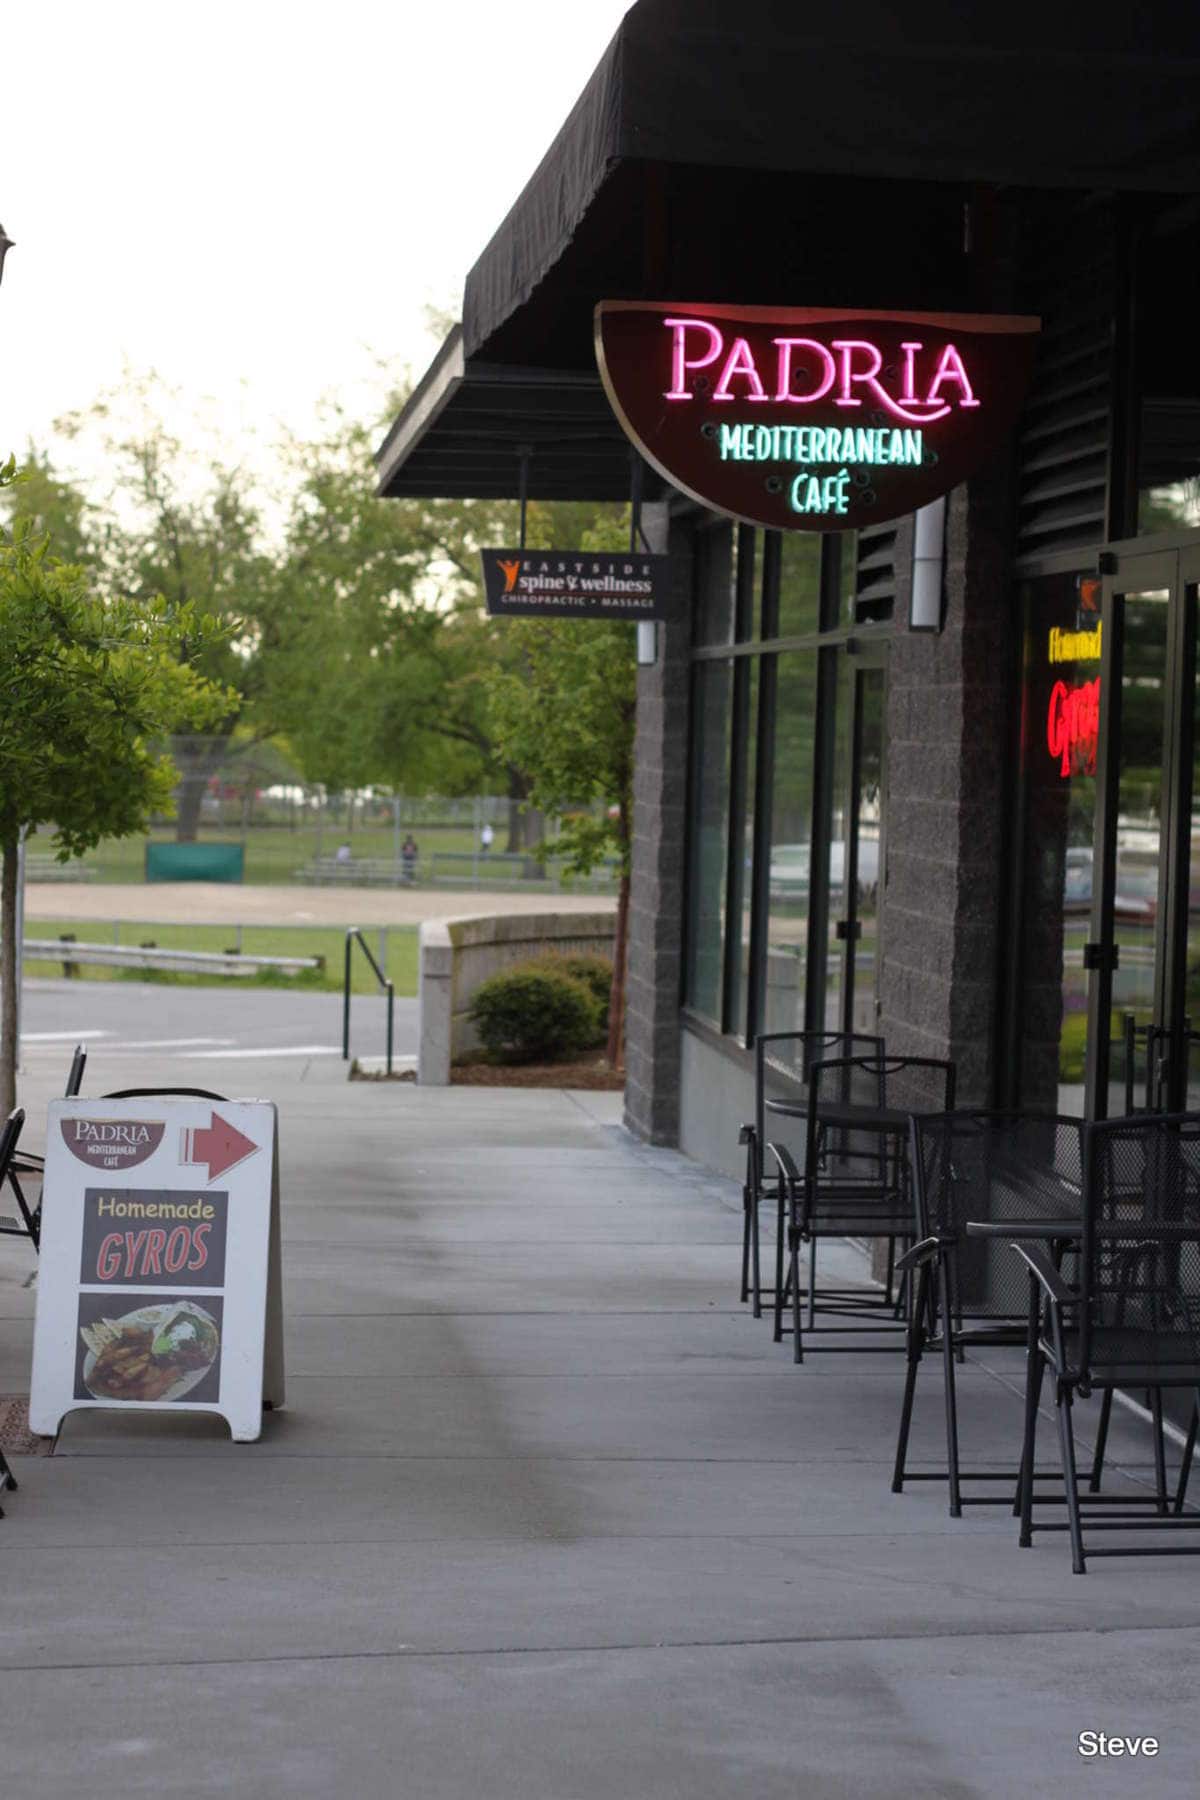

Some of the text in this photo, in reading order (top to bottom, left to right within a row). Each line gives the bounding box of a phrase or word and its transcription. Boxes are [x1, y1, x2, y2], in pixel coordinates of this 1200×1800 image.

[663, 318, 981, 422] PADRIA
[719, 423, 923, 466] MEDITERRANEAN
[790, 468, 851, 515] CAFÉ
[523, 561, 651, 575] EASTSIDE
[519, 574, 564, 593] spine
[581, 576, 652, 593] wellness
[501, 594, 654, 608] CHIROPRACTIC MASSAGE
[75, 1120, 151, 1145] PADRIA
[97, 1197, 216, 1219] Homemade
[96, 1223, 213, 1280] GYROS
